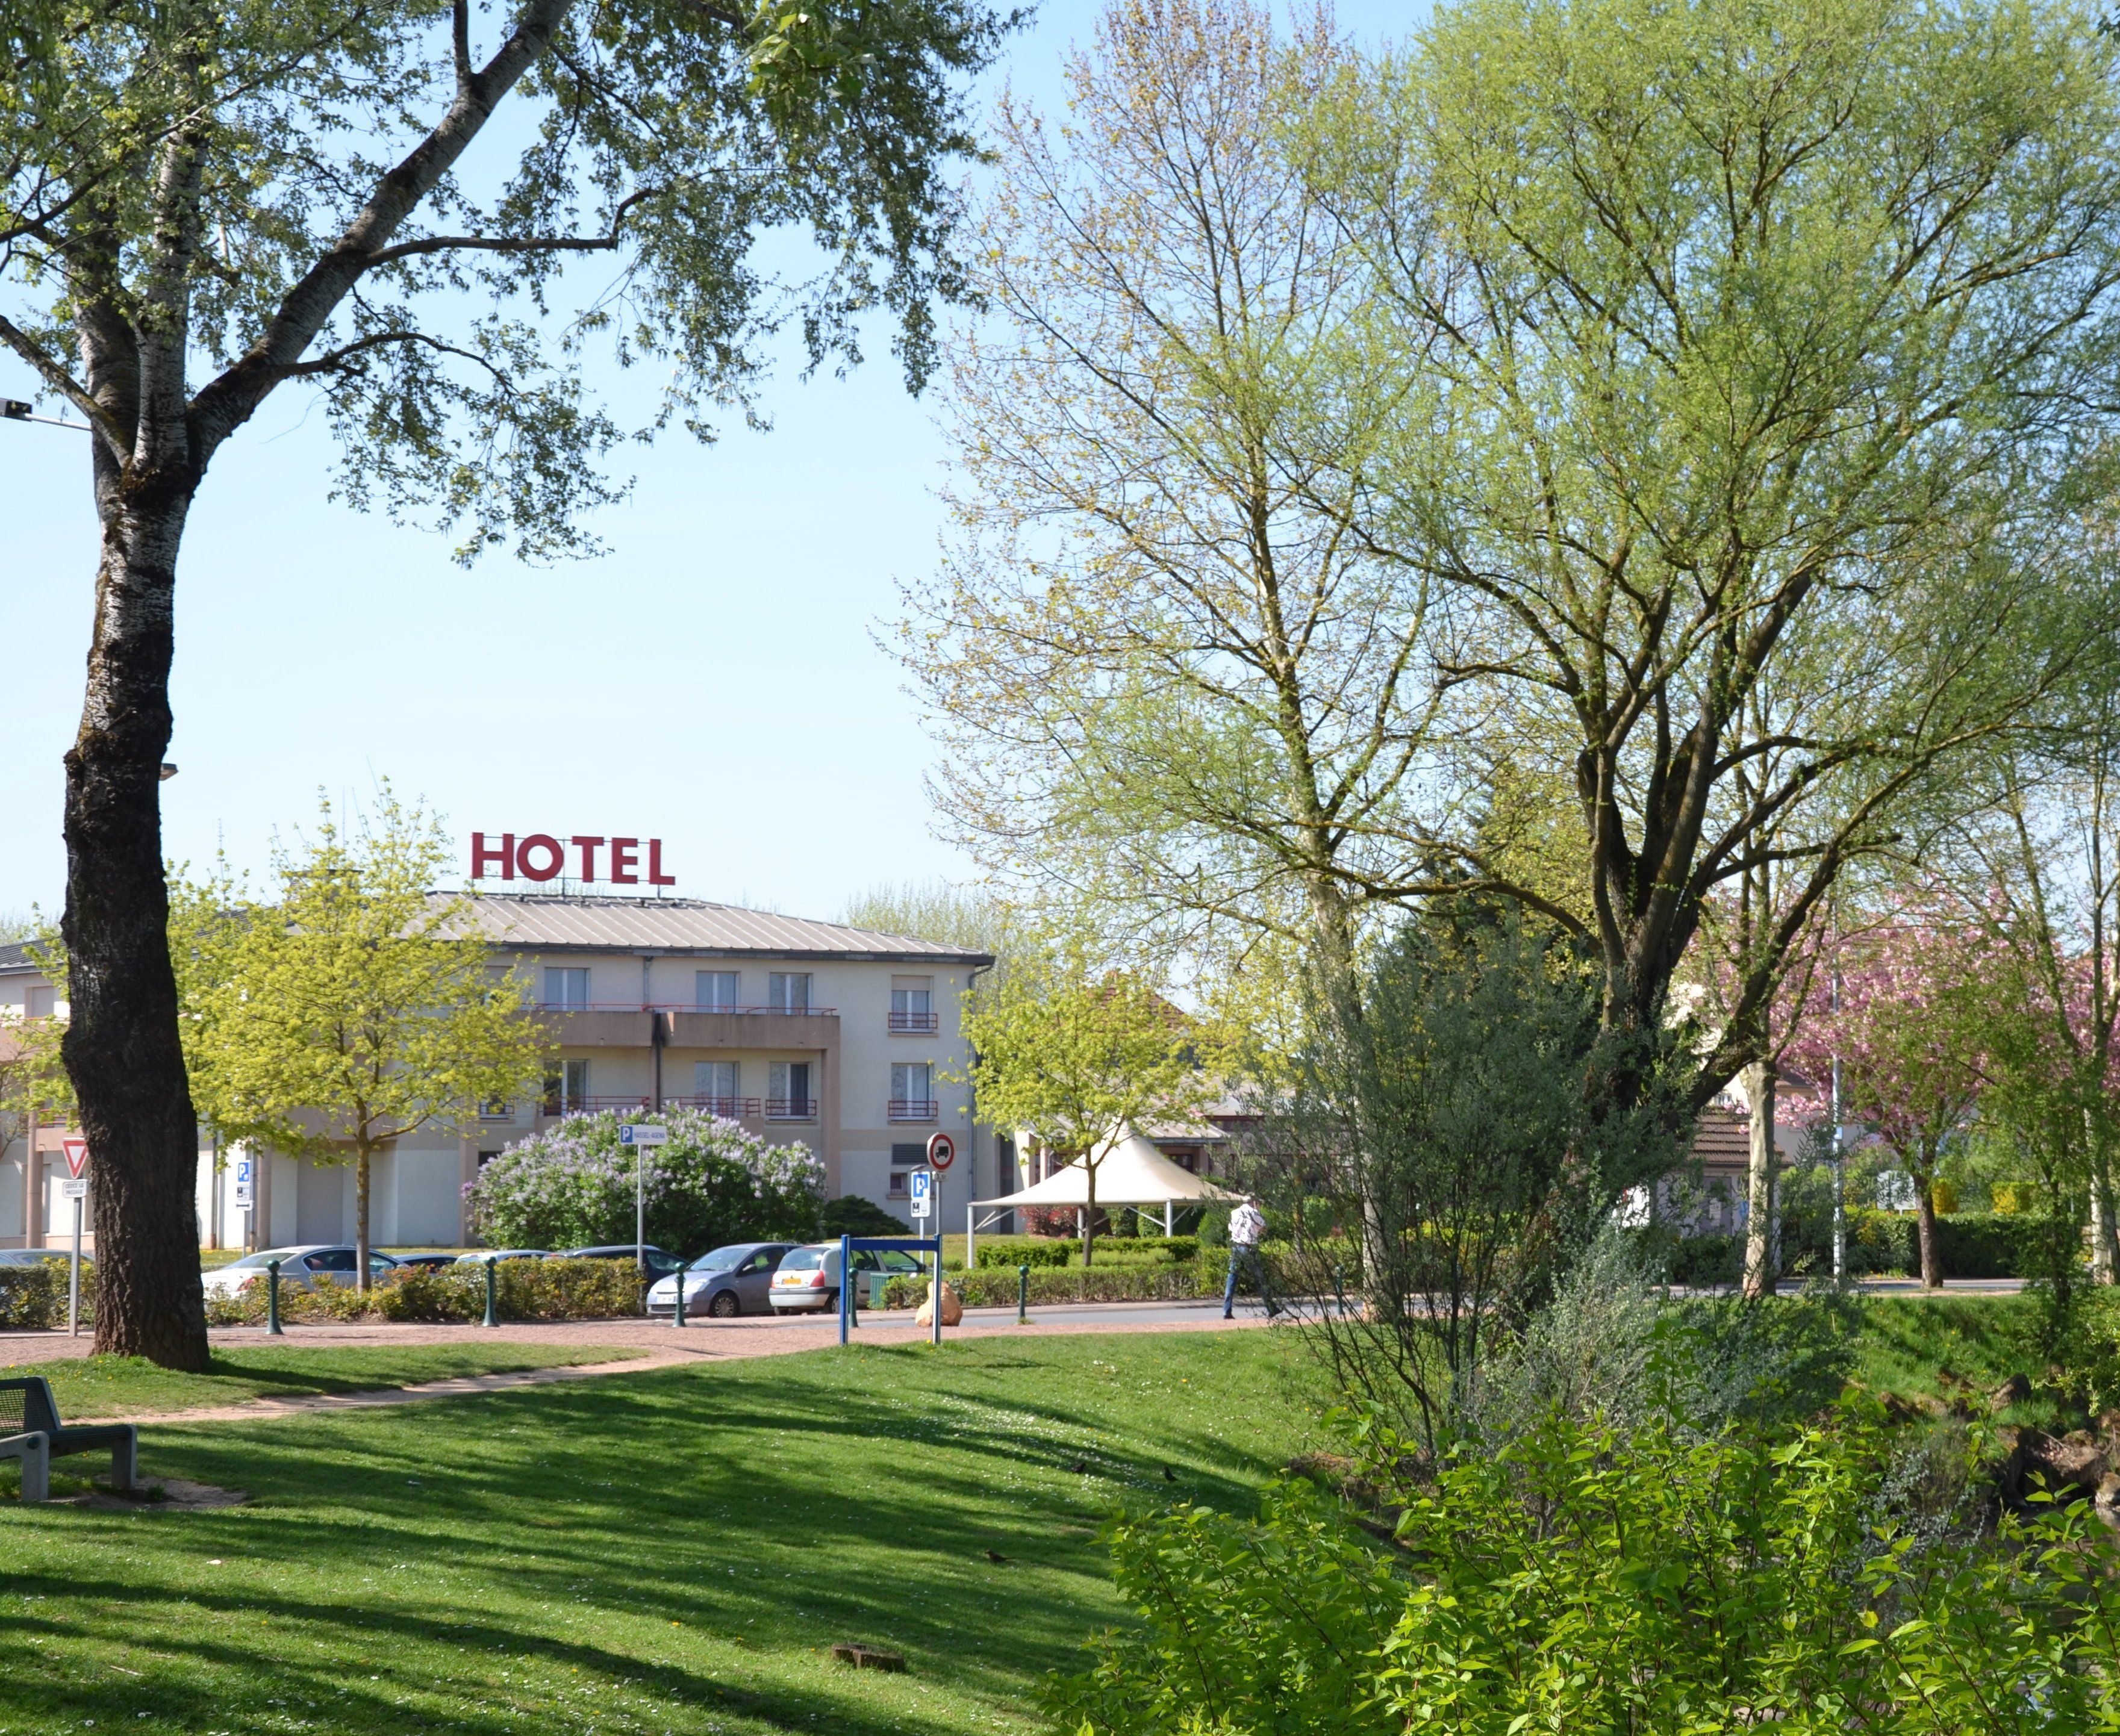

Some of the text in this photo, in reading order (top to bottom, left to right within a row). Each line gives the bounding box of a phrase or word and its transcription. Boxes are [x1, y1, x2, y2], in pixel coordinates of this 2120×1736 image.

[472, 832, 676, 885] HOTEL
[622, 1127, 630, 1140] P
[239, 1164, 246, 1178] P
[916, 1177, 925, 1195] P
